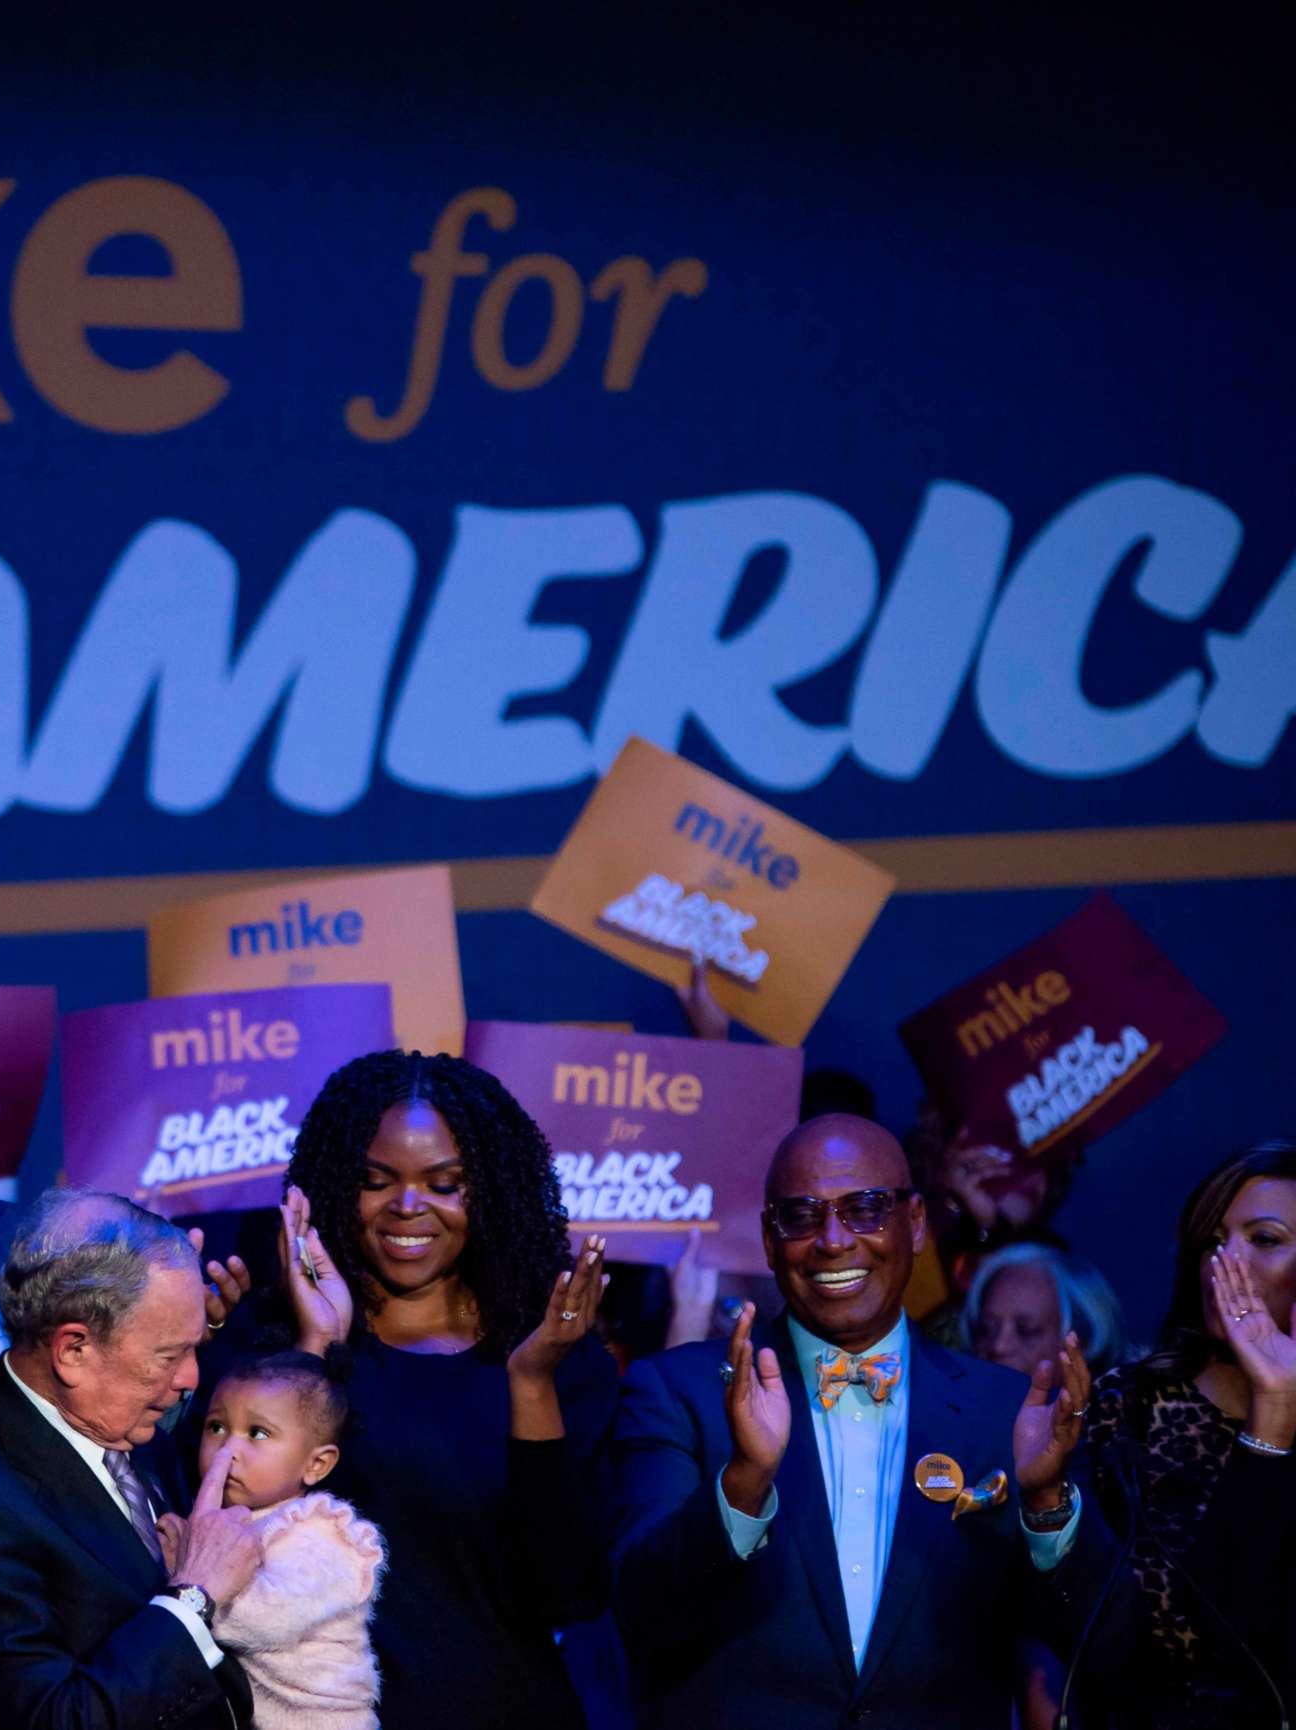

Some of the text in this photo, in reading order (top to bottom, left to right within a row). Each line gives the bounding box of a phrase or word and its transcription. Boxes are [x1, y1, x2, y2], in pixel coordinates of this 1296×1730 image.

[346, 187, 707, 443] for
[674, 800, 800, 892] mike
[229, 899, 365, 959] mike
[152, 1008, 300, 1071] mike
[957, 970, 1071, 1059] mike
[553, 1051, 704, 1117] mike
[1007, 1025, 1096, 1118] BLACK
[1018, 1024, 1150, 1149] AMERICA
[158, 1095, 290, 1151] BLACK
[605, 1117, 646, 1146] for
[139, 1125, 301, 1187] AMERIC
[559, 1182, 714, 1222] MERICA
